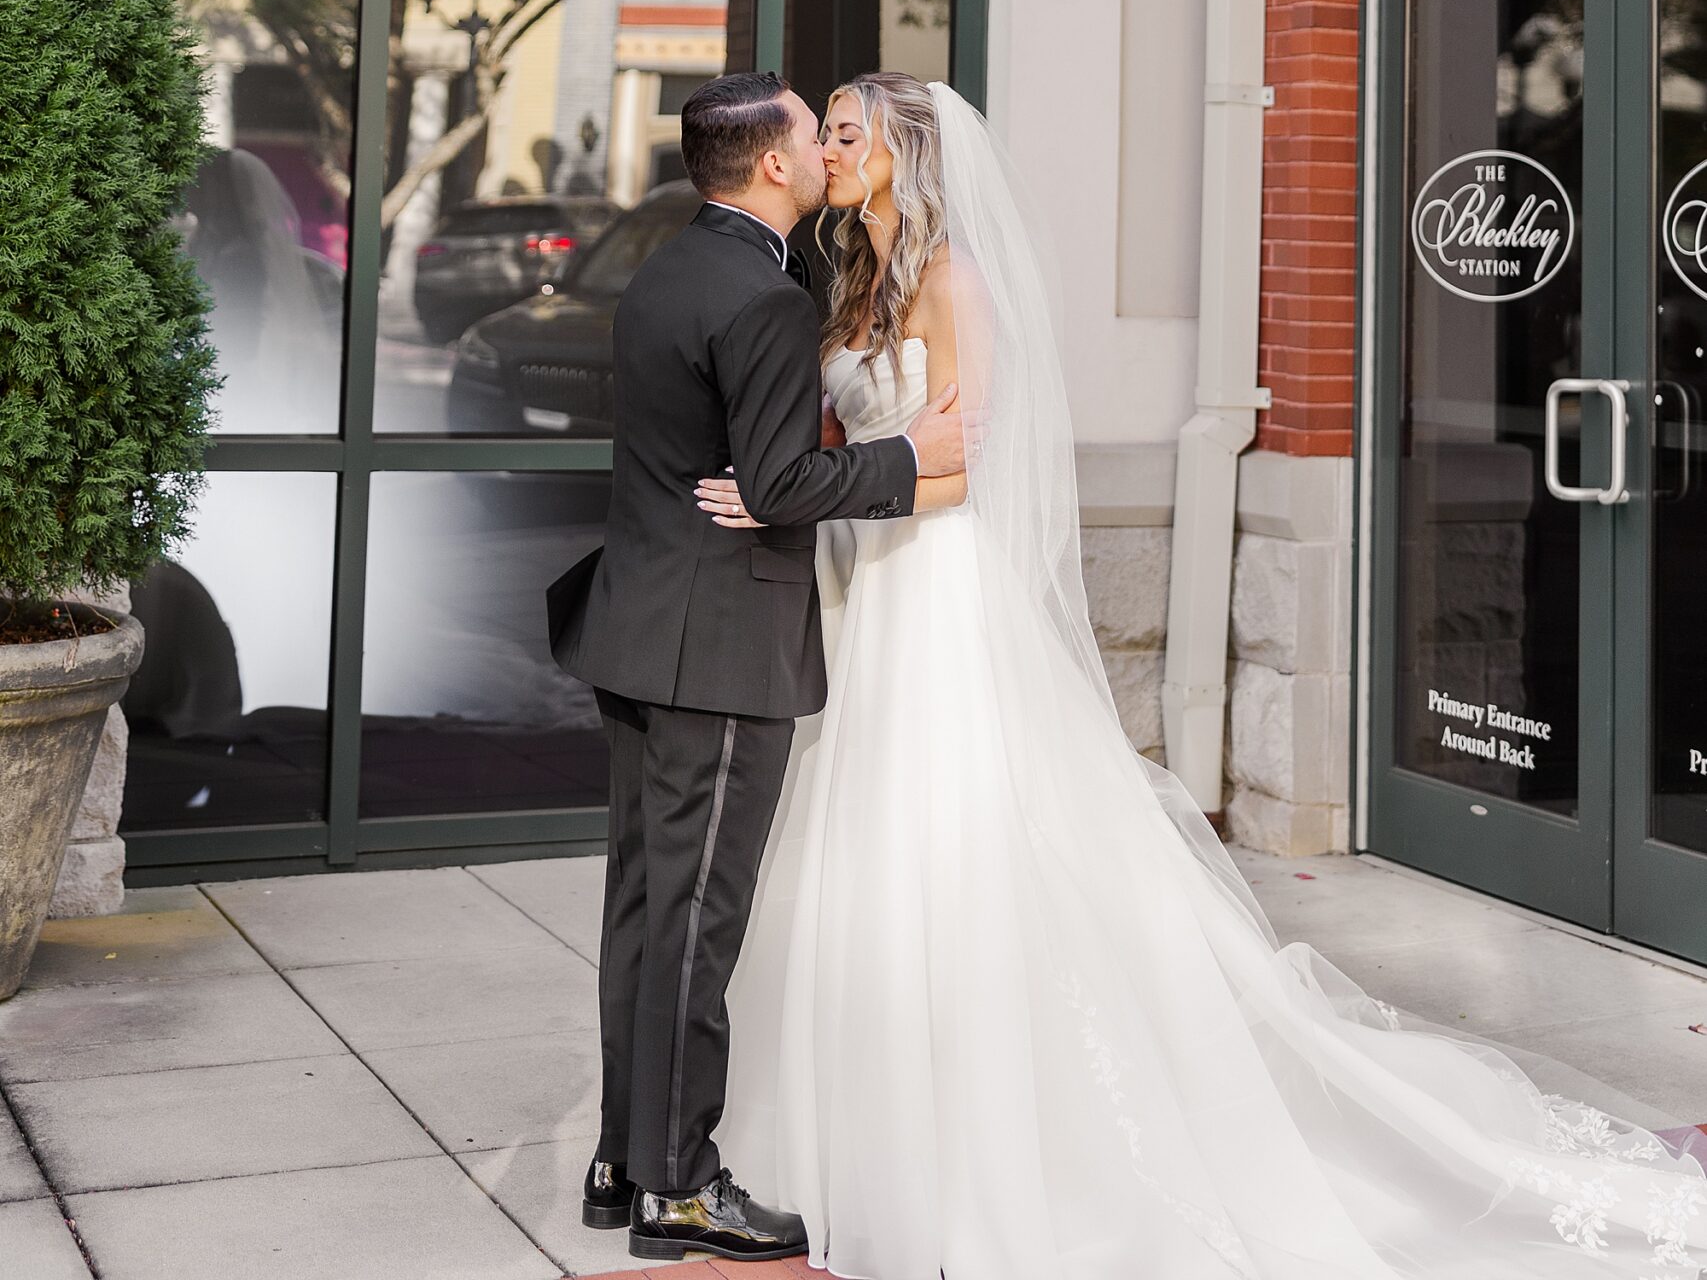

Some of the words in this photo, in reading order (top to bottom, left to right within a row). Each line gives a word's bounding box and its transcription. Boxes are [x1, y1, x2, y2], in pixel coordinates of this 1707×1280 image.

[1475, 165, 1506, 182] THE
[1418, 183, 1560, 282] Bleckley
[1459, 259, 1521, 276] STATION
[1428, 689, 1485, 729] Primary
[1487, 704, 1552, 740] Entrance
[1440, 725, 1497, 760] Around
[1499, 740, 1536, 770] Back
